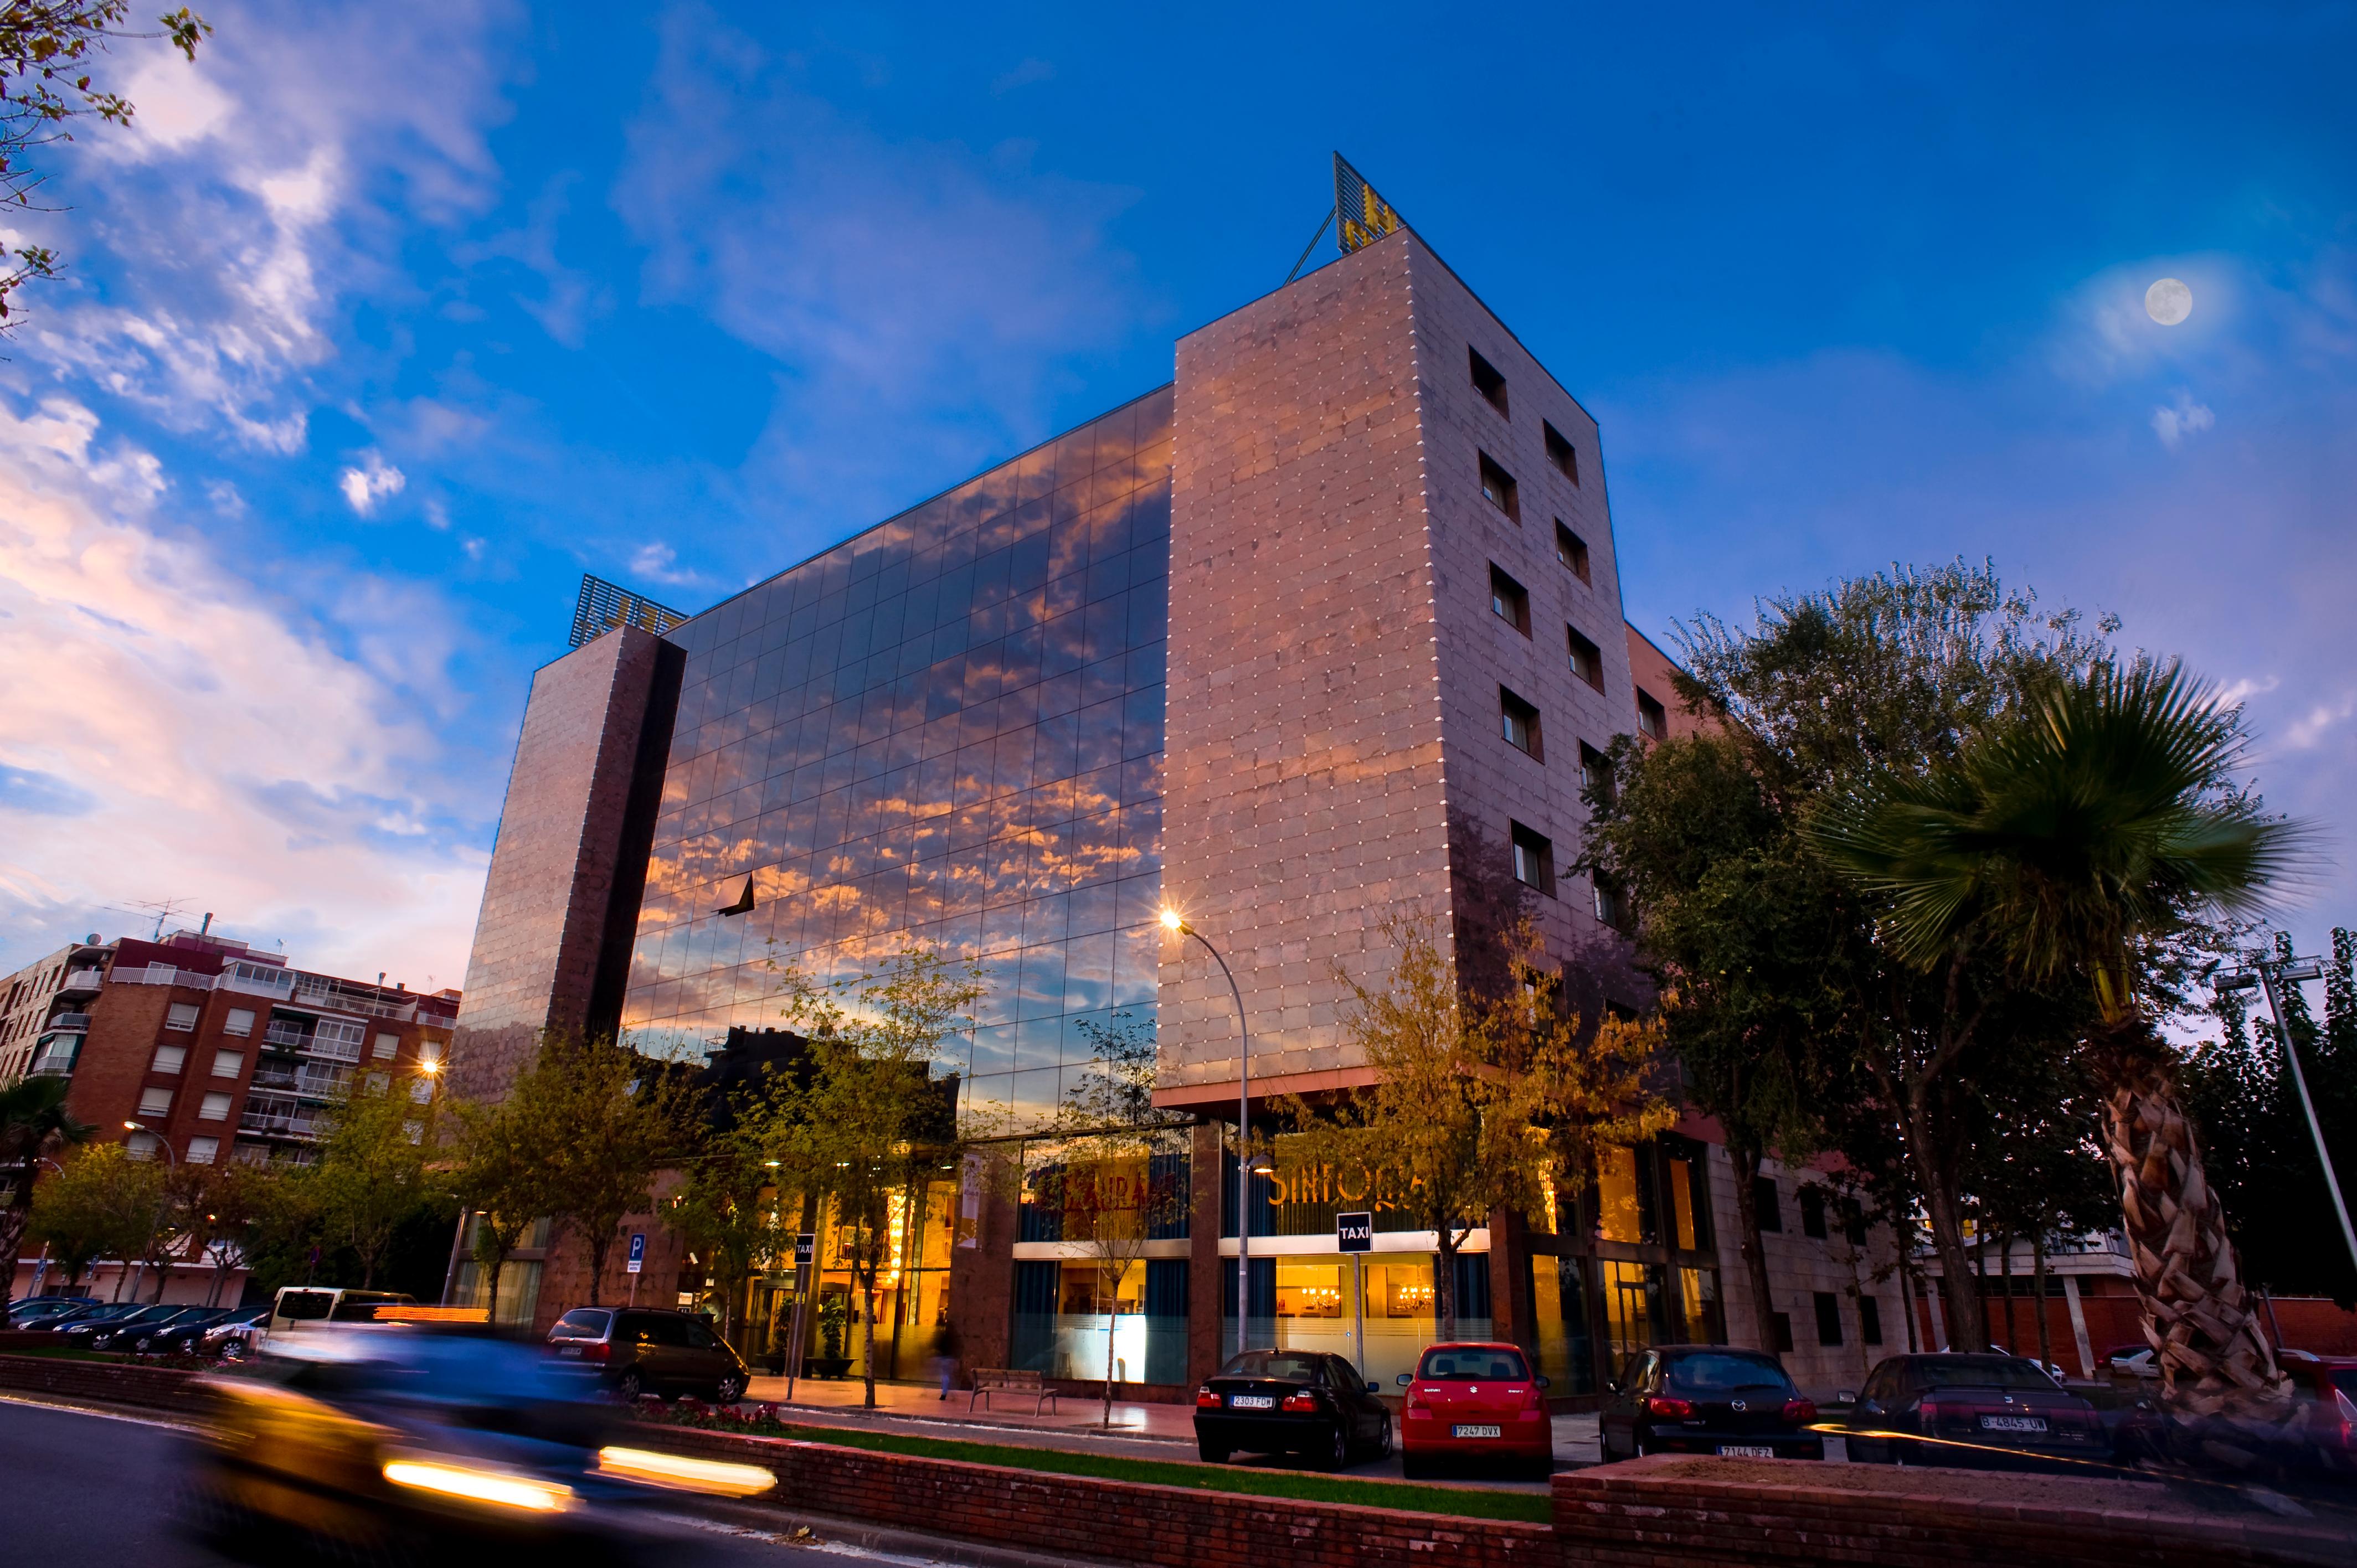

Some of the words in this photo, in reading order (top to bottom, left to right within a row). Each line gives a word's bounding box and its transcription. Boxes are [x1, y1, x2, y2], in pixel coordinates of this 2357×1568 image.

[1340, 1226, 1369, 1239] TAXI
[631, 1237, 642, 1257] P
[797, 1245, 812, 1254] TAXI
[1235, 1396, 1254, 1405] 2303
[1256, 1397, 1271, 1406] FDW
[1458, 1426, 1479, 1435] 7247
[1482, 1427, 1499, 1436] DVX
[1724, 1447, 1748, 1457] 7144
